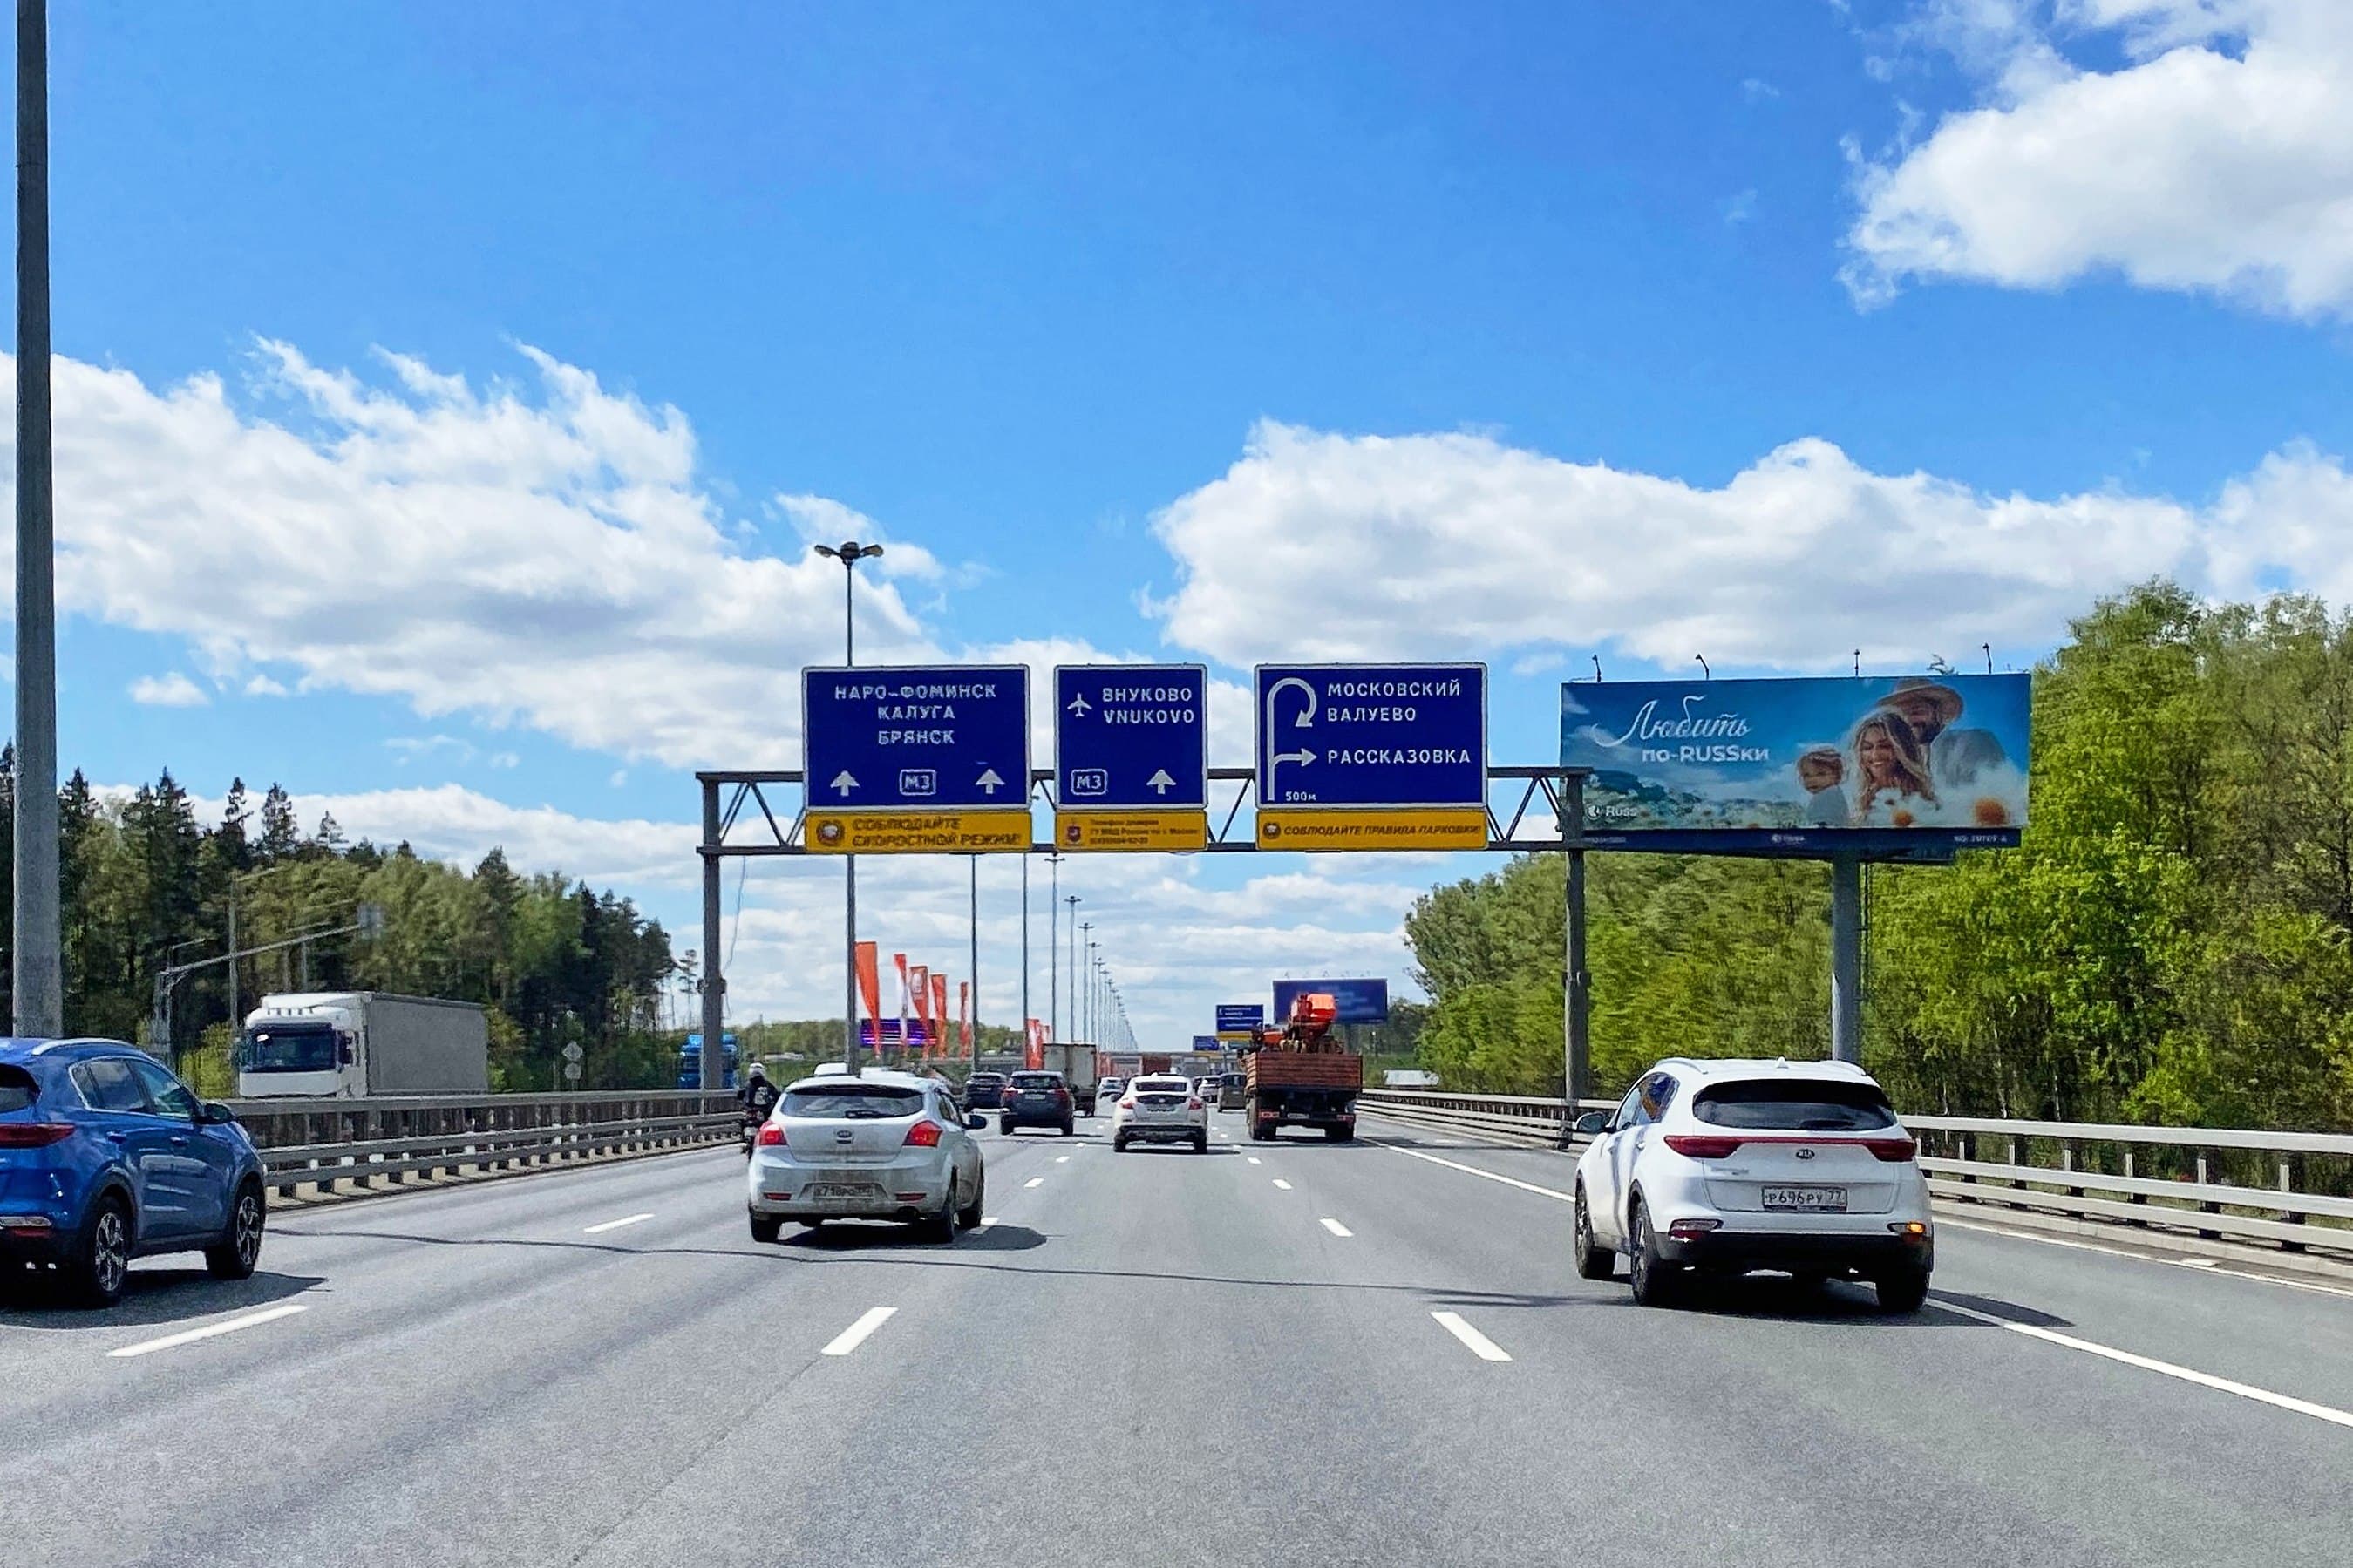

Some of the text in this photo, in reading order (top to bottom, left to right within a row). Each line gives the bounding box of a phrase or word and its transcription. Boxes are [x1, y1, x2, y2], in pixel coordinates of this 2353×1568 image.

[834, 683, 996, 700] НАРО-ФОМИНСК
[1102, 687, 1192, 703] ВНУКОВО
[1327, 678, 1461, 697] МОСКОВСКИЙ
[877, 705, 955, 720] КАЛУГА
[1103, 709, 1194, 724] VNUKOVO
[1327, 707, 1417, 722] ВАЛУЕВО
[1591, 695, 1752, 747] Любить
[878, 730, 955, 745] БРЯНСК
[1328, 749, 1472, 764] РАССКАЗОВКА
[1642, 745, 1770, 763] по-RUSSки
[1605, 805, 1638, 818] Russ
[1283, 825, 1362, 836] СОБЛЮДАЙТЕ
[1364, 825, 1416, 836] ПРАВИЛА
